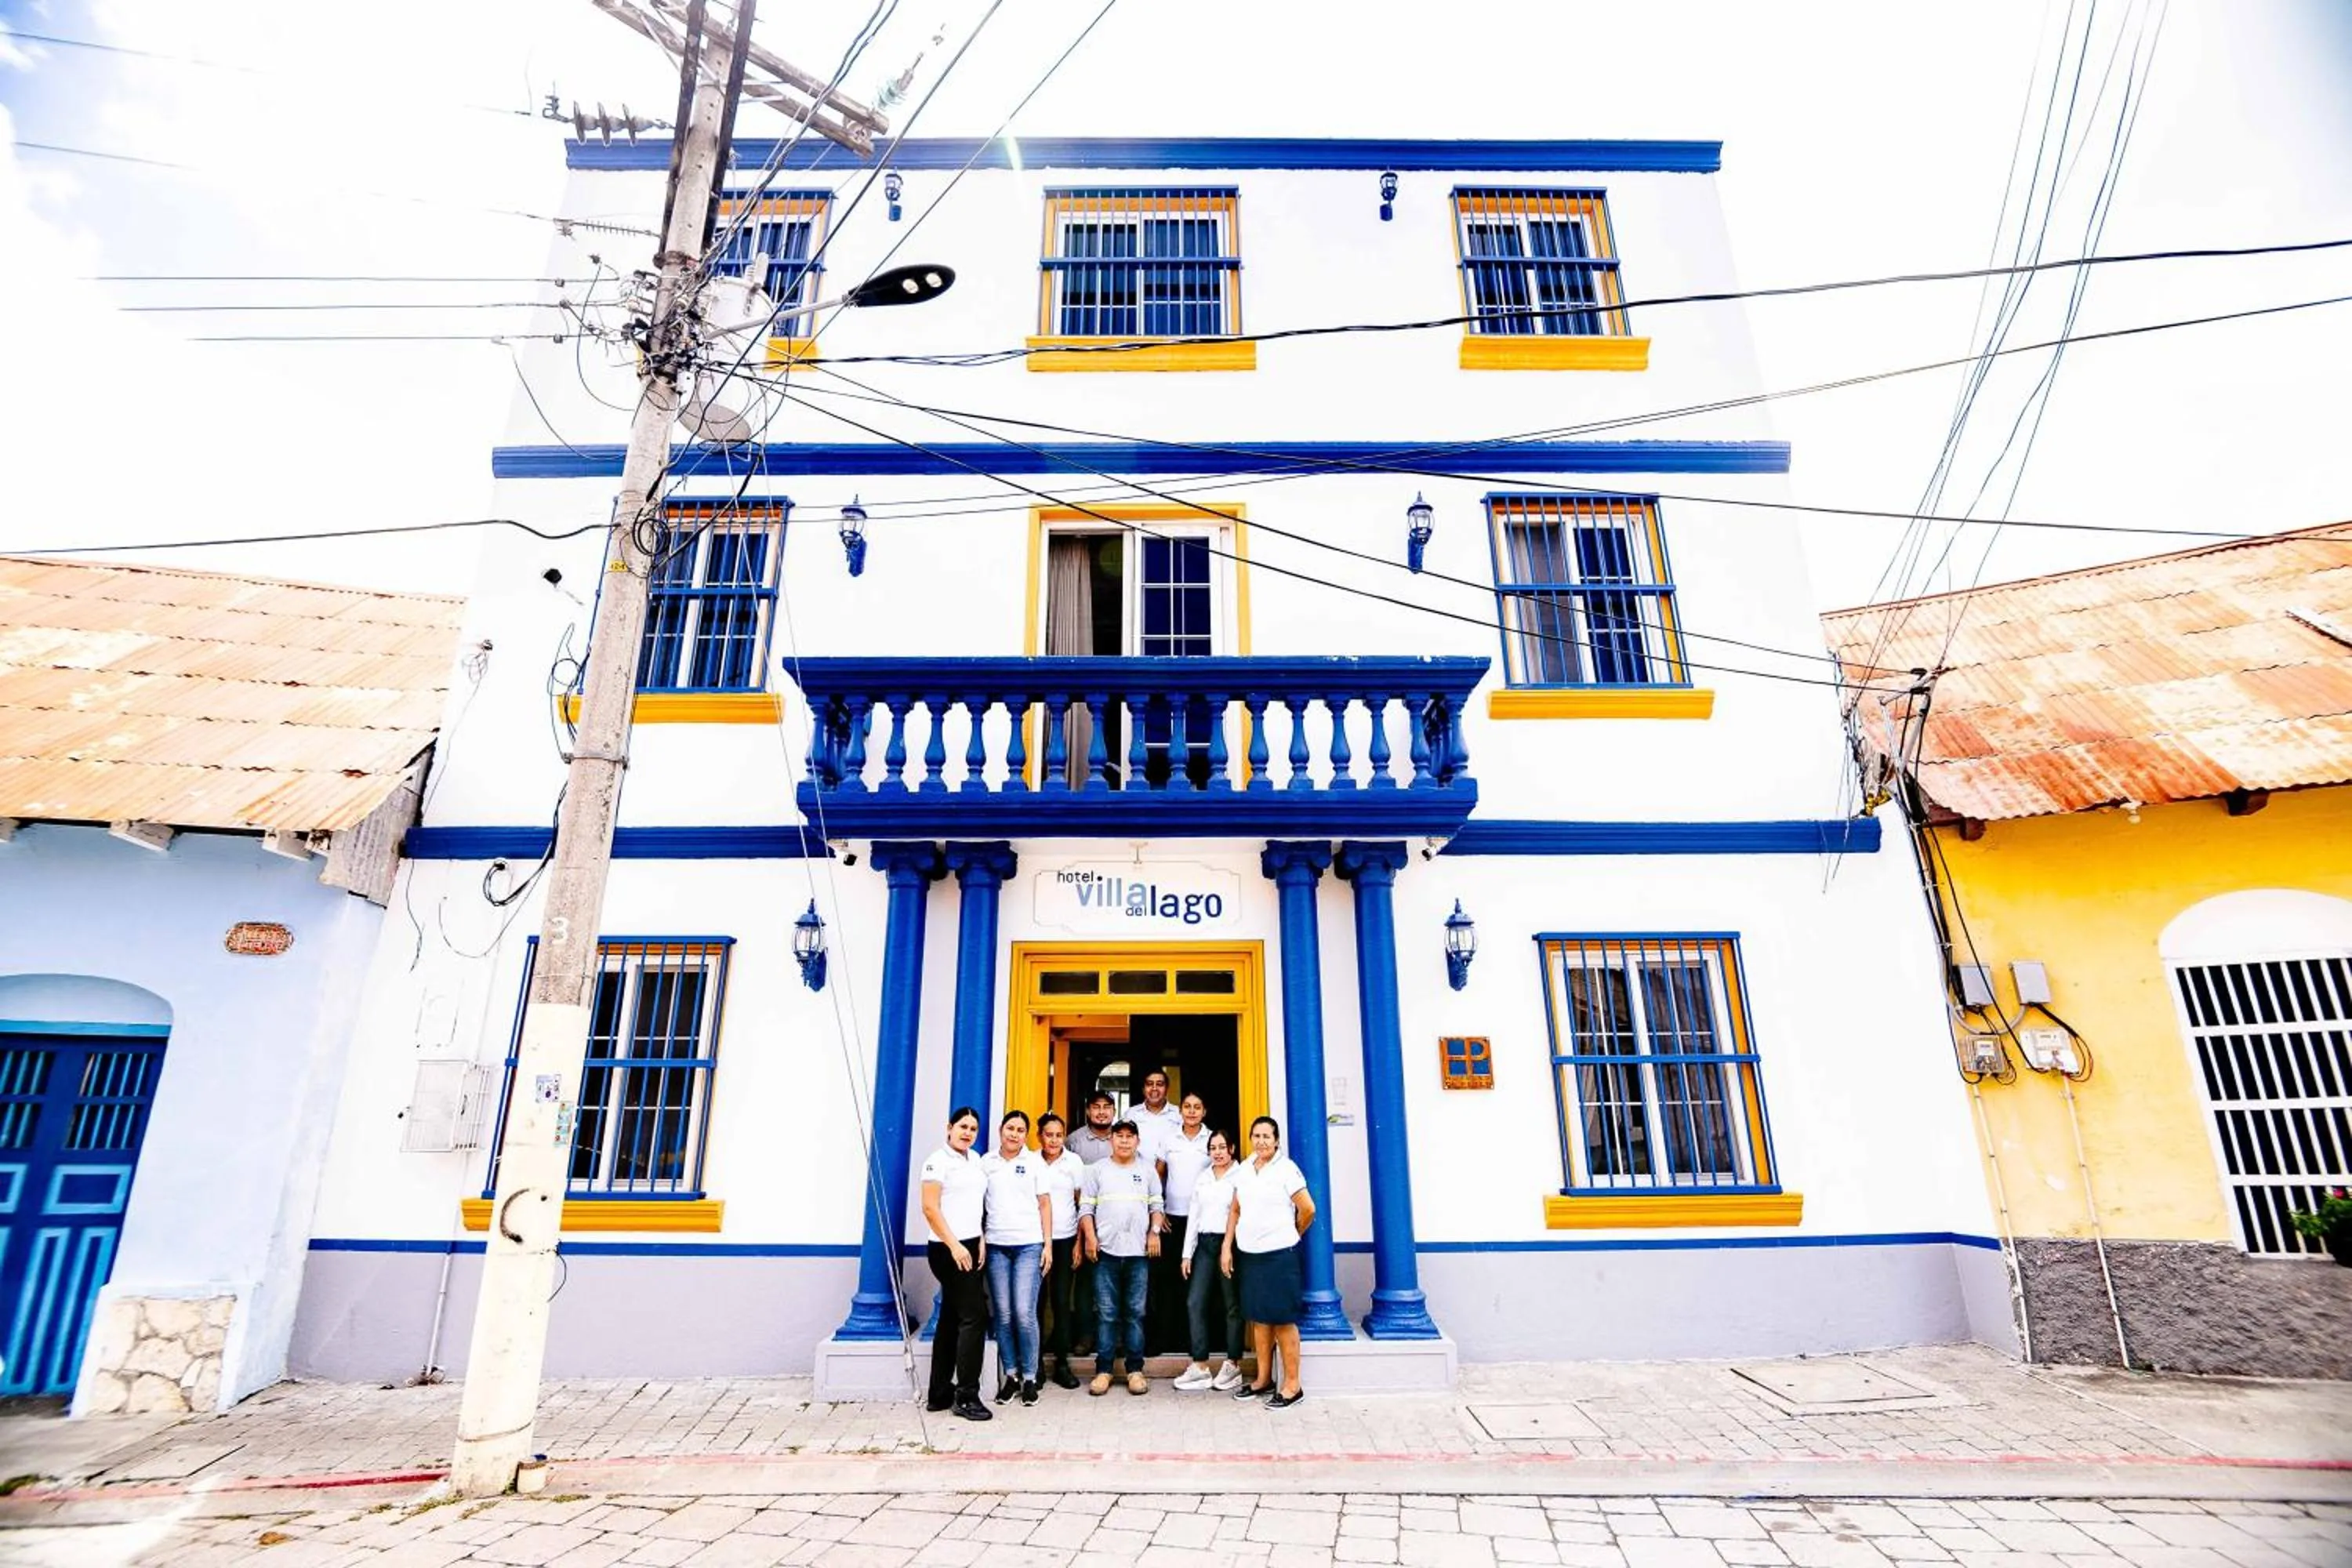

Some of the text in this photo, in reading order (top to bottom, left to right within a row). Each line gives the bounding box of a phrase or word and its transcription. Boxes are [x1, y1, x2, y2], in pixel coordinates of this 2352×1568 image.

[1057, 869, 1094, 883] hotel
[1076, 876, 1147, 907] villa
[1125, 884, 1222, 924] del lago
[550, 916, 570, 945] 3
